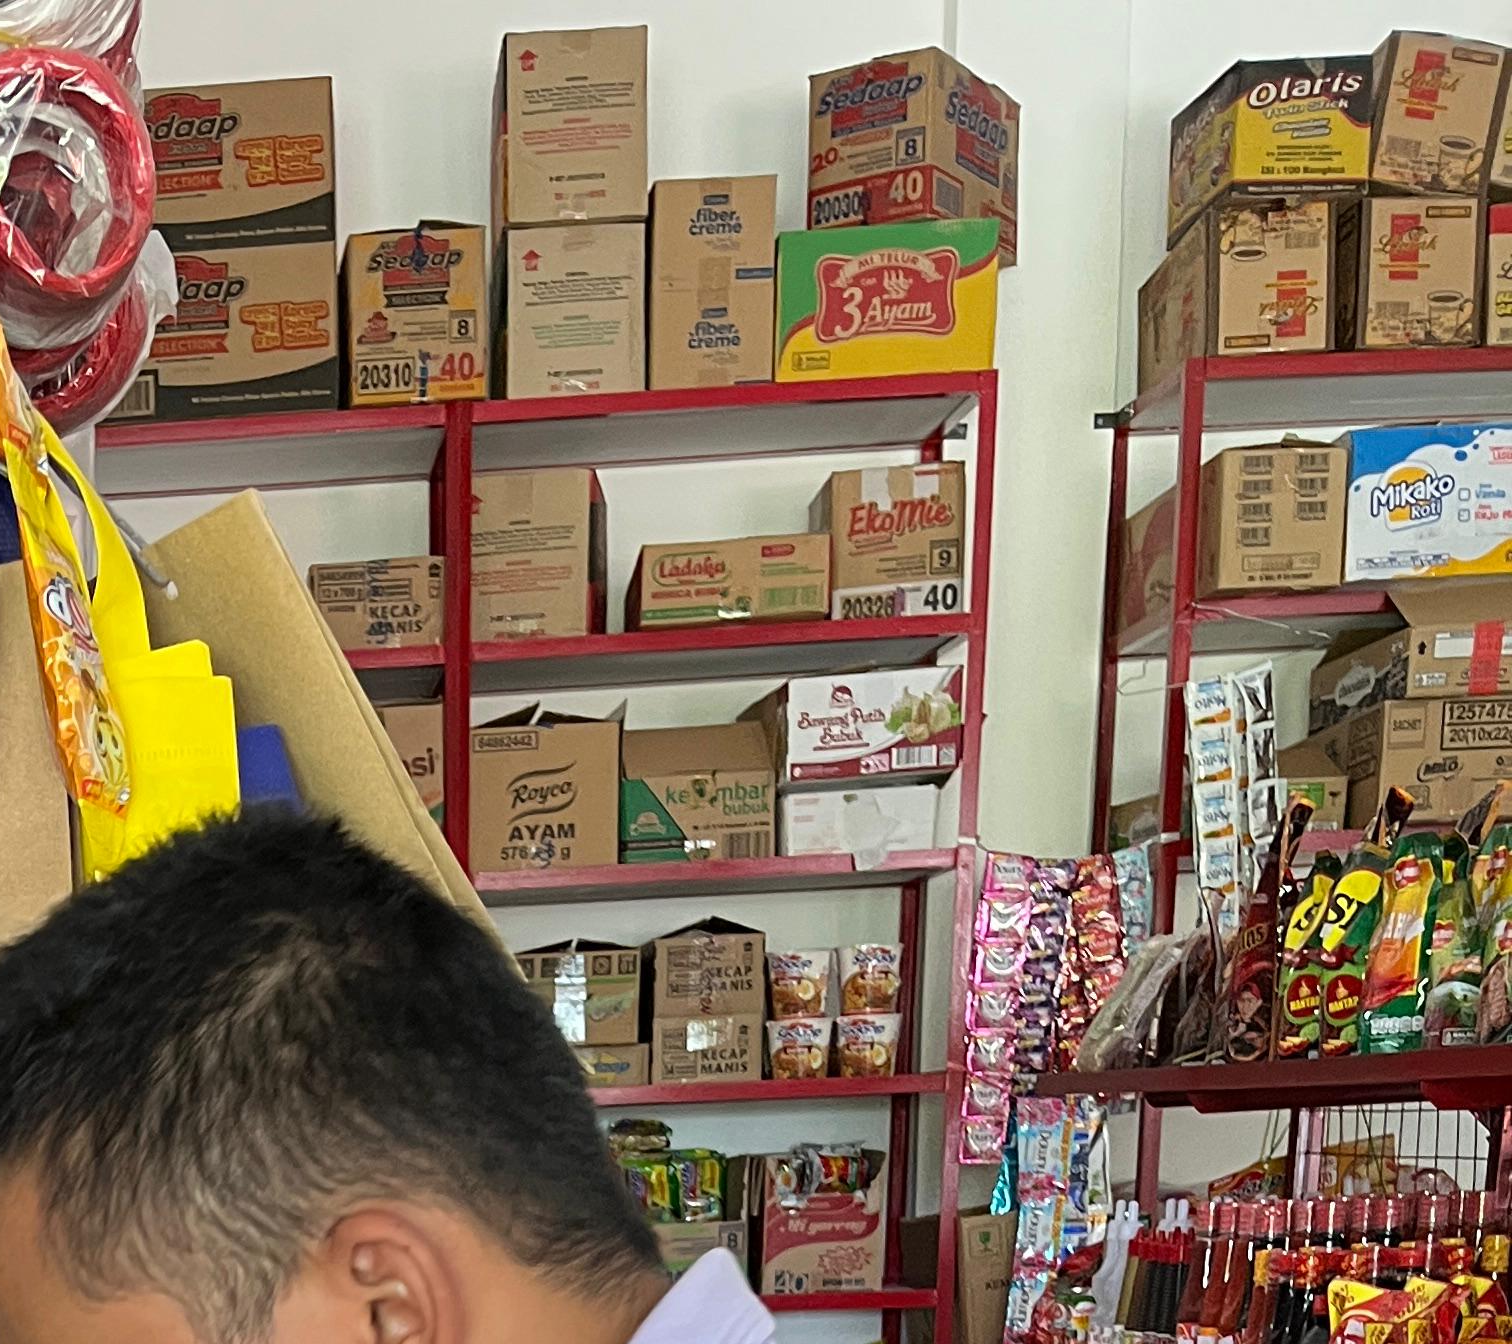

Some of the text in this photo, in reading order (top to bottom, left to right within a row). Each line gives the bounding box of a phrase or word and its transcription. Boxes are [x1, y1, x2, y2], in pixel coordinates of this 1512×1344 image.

[816, 74, 925, 118] Sedaap
[1249, 73, 1363, 107] Olaris
[147, 113, 239, 139] daap
[904, 138, 917, 156] 8
[889, 170, 924, 203] 40
[689, 219, 742, 236] creme
[696, 207, 737, 224] fiber
[879, 252, 920, 267] TELUR
[834, 286, 935, 339] 3 Ayam
[457, 319, 470, 337] 8
[694, 320, 737, 338] fiber
[689, 332, 741, 349] creme
[360, 362, 412, 390] 20310
[441, 351, 475, 381] 40
[1371, 475, 1455, 517] Mikako
[847, 494, 955, 538] EkoMie
[938, 549, 952, 569] 9
[923, 583, 959, 612] 40
[510, 777, 577, 809] Royco
[665, 781, 771, 805] kembar
[508, 823, 576, 842] AYAM
[700, 1049, 749, 1061] KECAP
[699, 1062, 749, 1075] MANIS
